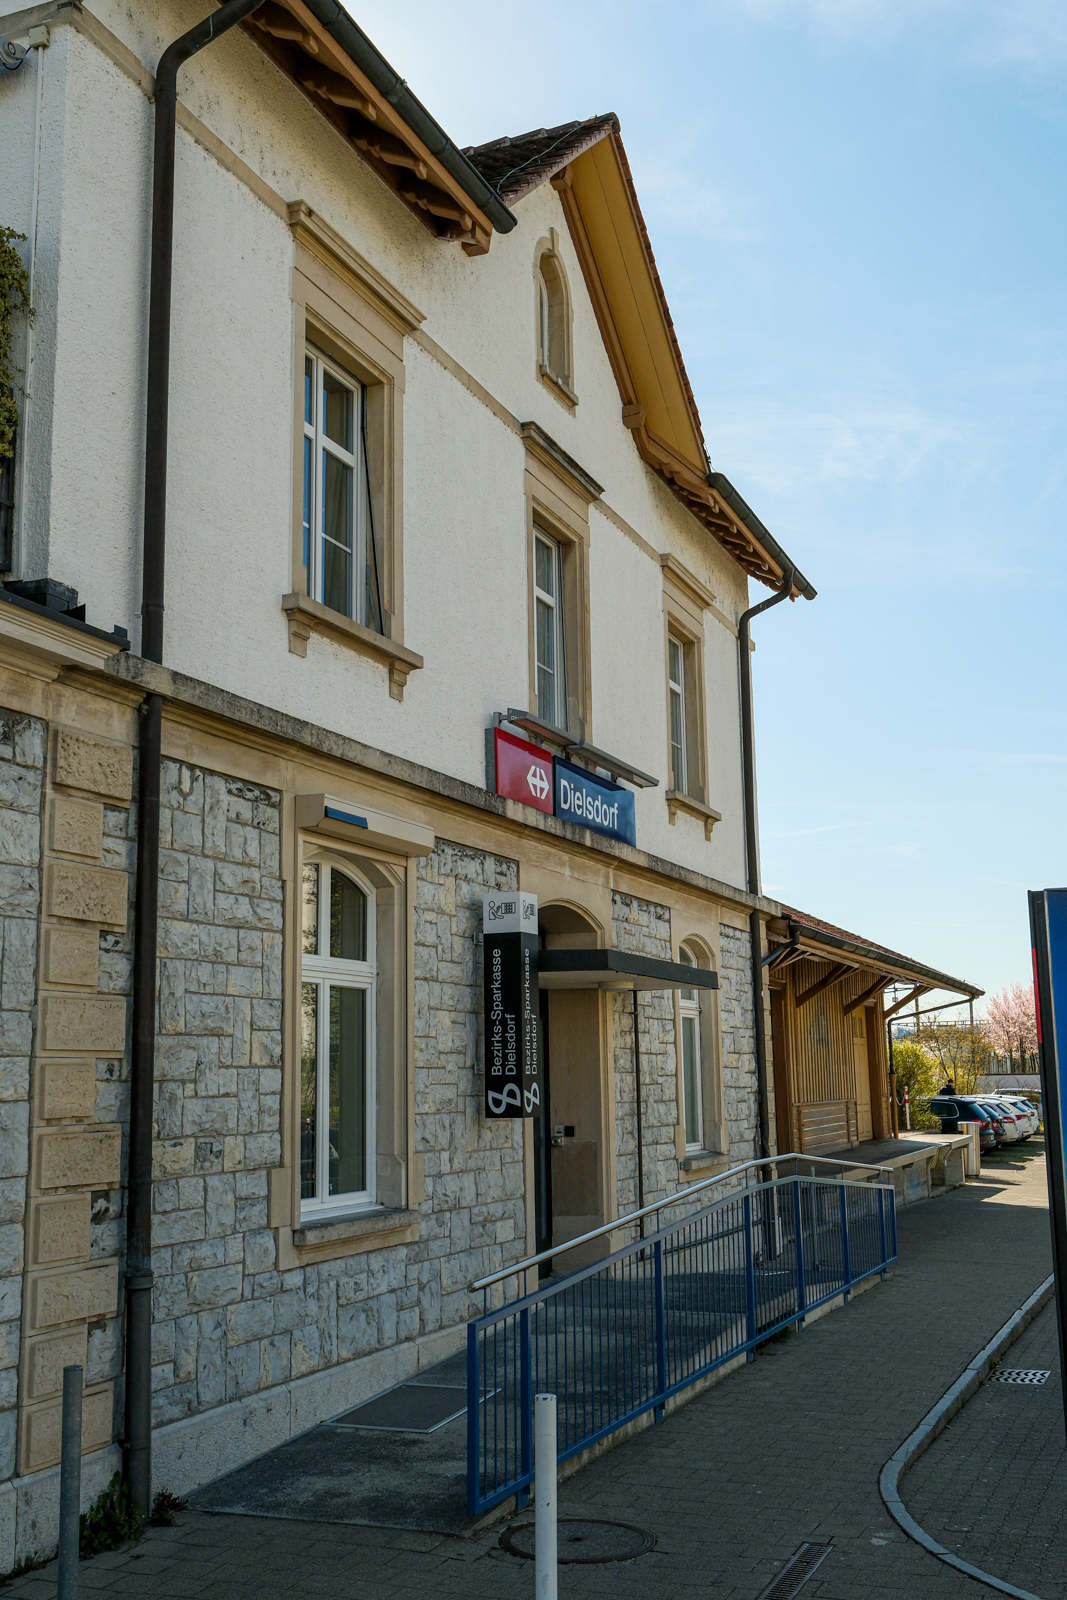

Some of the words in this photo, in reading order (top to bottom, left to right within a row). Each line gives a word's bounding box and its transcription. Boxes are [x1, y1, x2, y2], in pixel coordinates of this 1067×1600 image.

[560, 778, 618, 829] Dielsdorf
[491, 948, 504, 1075] Bezirks-Sparkasse
[505, 1013, 517, 1075] Dielsdorf
[524, 948, 532, 1075] Bezirks-Sparkasse
